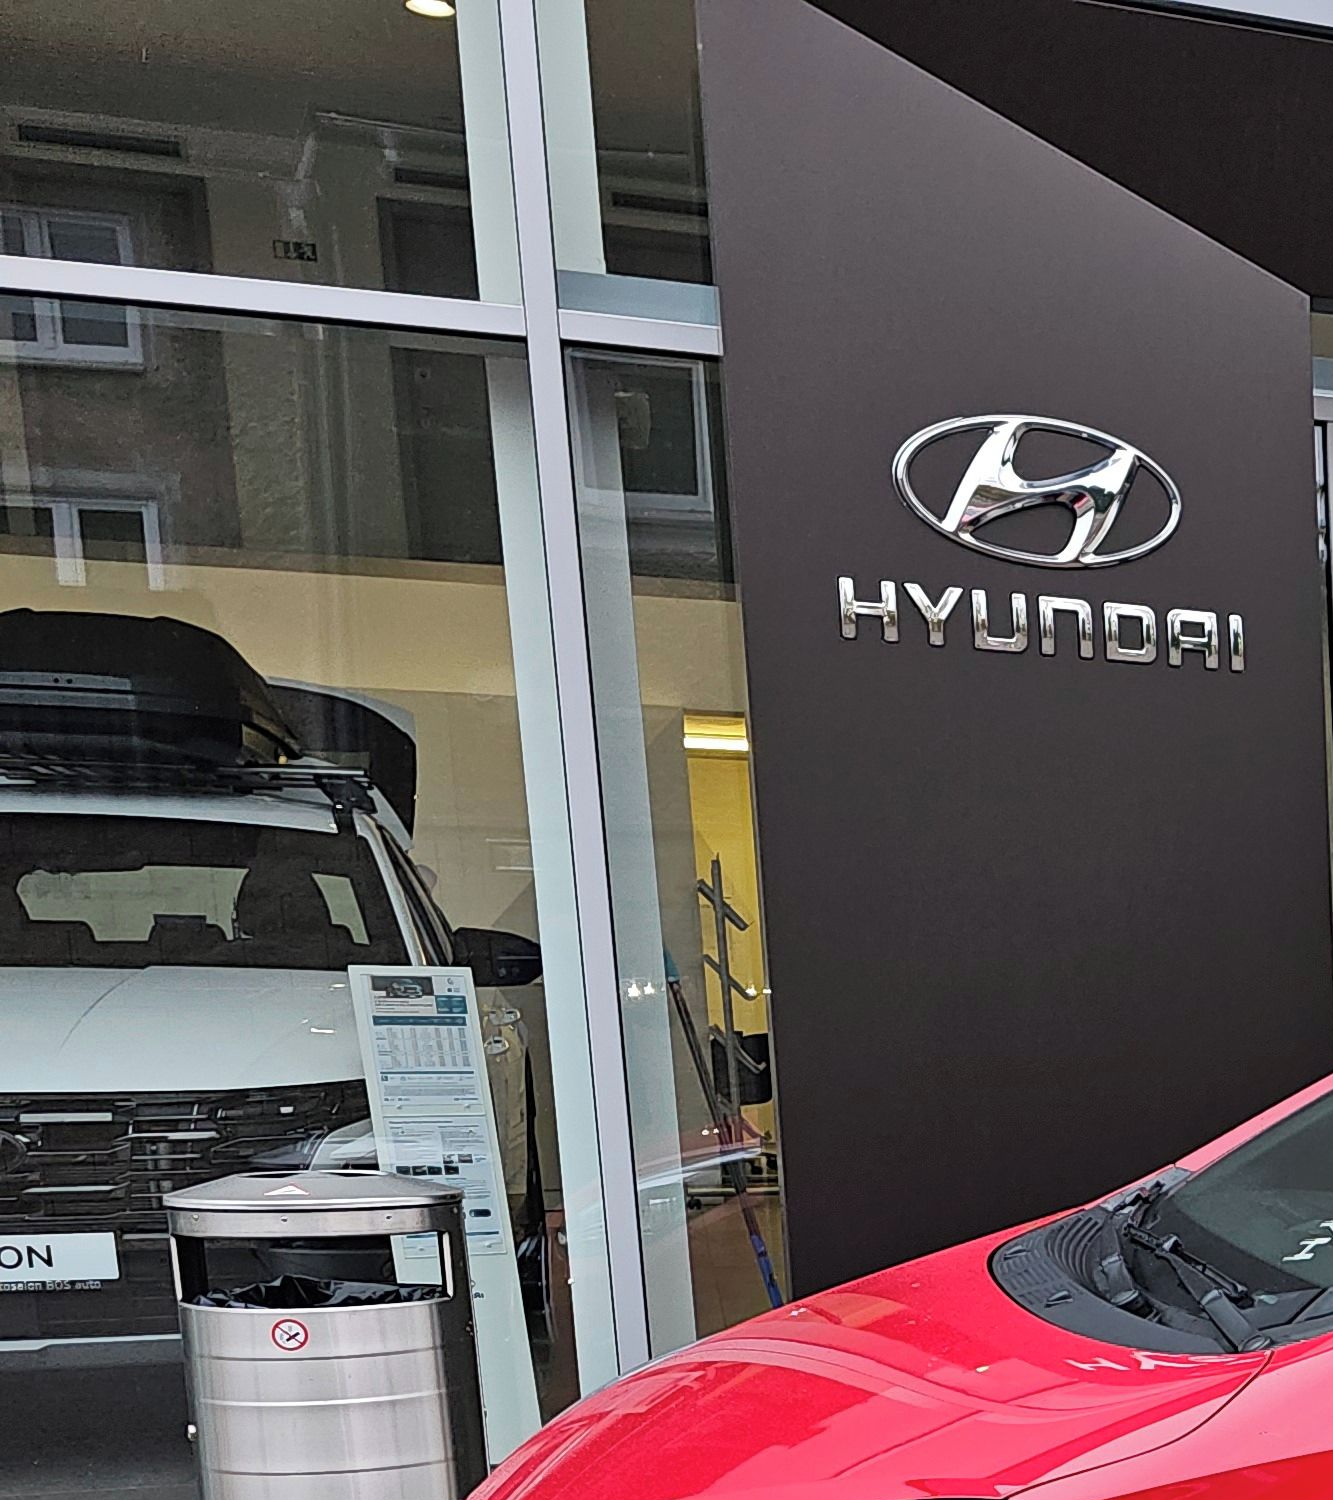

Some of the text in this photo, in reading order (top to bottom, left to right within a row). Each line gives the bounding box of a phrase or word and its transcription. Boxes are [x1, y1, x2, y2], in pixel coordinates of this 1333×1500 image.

[838, 576, 1246, 672] HYUNDAI
[0, 1244, 54, 1270] ON
[46, 1280, 71, 1291] BOS
[75, 1279, 102, 1290] auto
